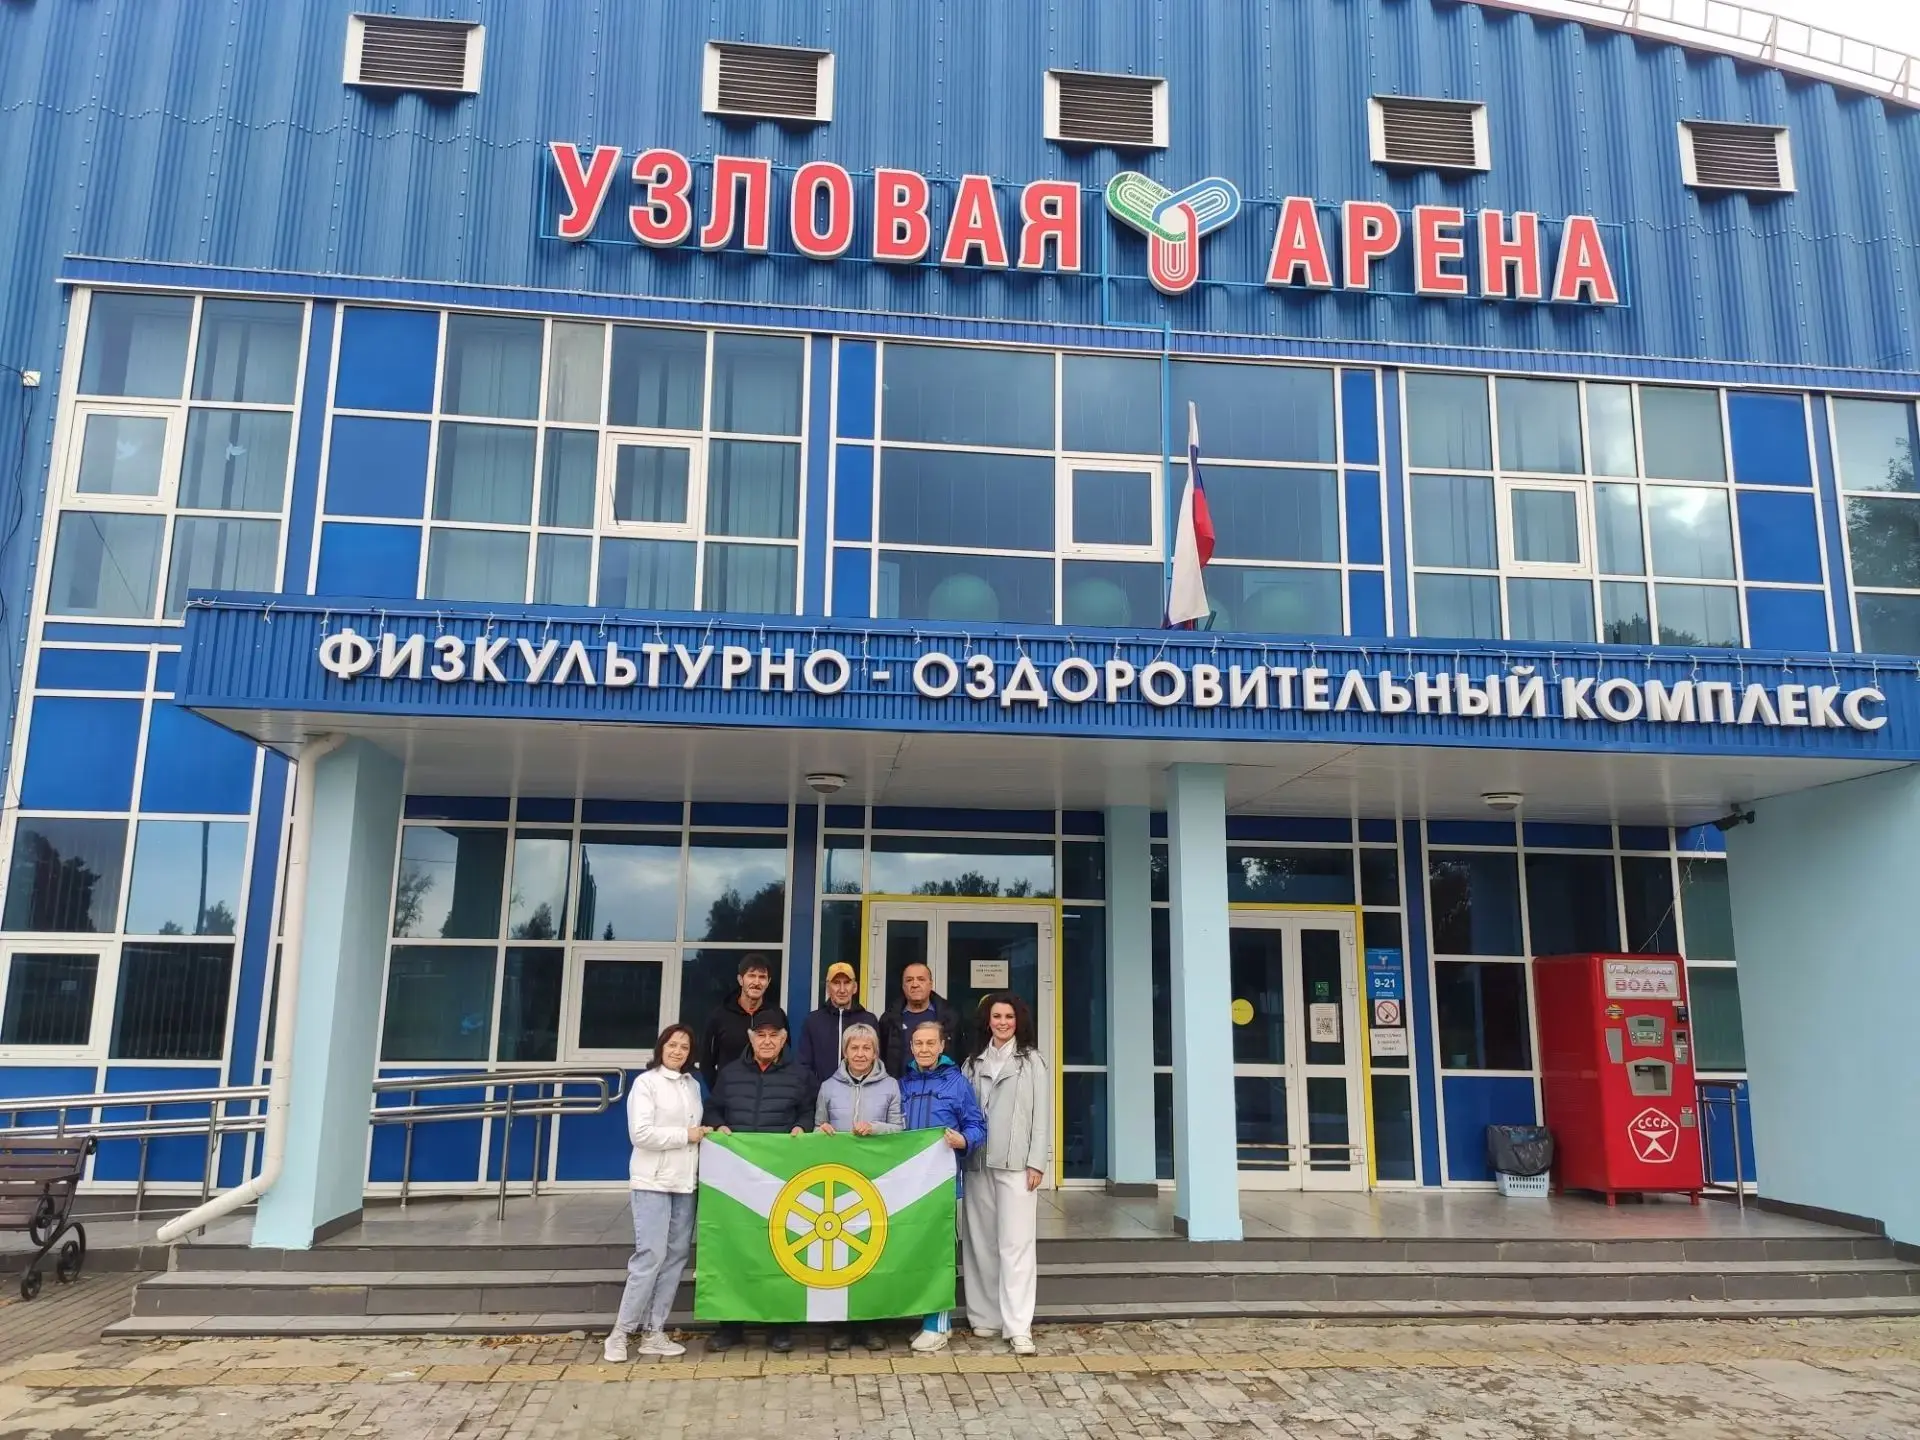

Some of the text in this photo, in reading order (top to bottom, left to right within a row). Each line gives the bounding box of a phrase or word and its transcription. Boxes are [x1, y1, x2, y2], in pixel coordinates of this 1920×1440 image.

[549, 141, 1619, 305] УЗЛОВАЯ АРЕНА
[319, 628, 850, 695] ФИЗКУЛЬТУРНО
[913, 652, 1546, 719] ОЗДОРОВИТЕЛЬНЫЙ
[1561, 677, 1888, 731] КОМПЛЕКС
[1374, 978, 1396, 988] 9-21
[1615, 978, 1669, 993] ВОДА
[1638, 1116, 1669, 1130] СССР
